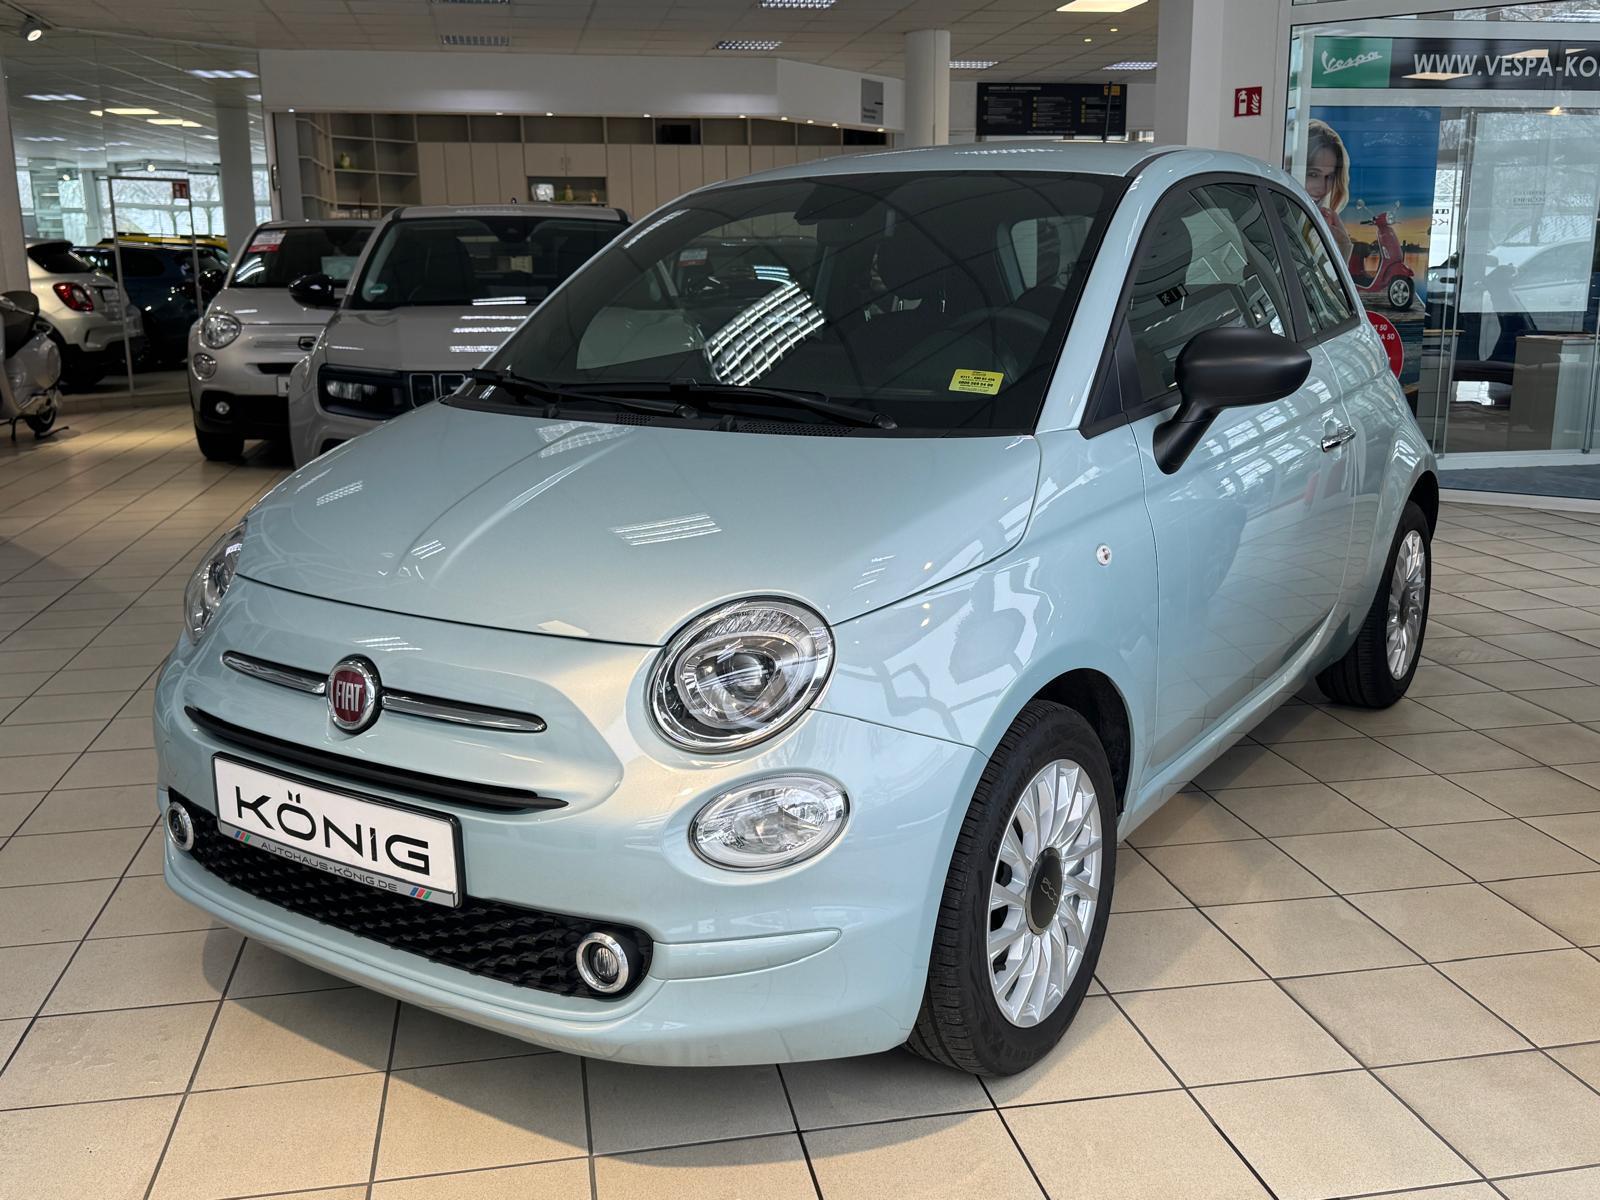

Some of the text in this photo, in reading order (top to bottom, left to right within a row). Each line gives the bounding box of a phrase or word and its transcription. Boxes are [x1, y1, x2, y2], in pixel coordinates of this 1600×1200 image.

[1321, 50, 1383, 75] Vespa
[1414, 53, 1600, 78] WWW.VESPA-KO
[1386, 333, 1395, 341] 50
[335, 680, 363, 712] FIAT
[235, 785, 430, 876] KÖNIG
